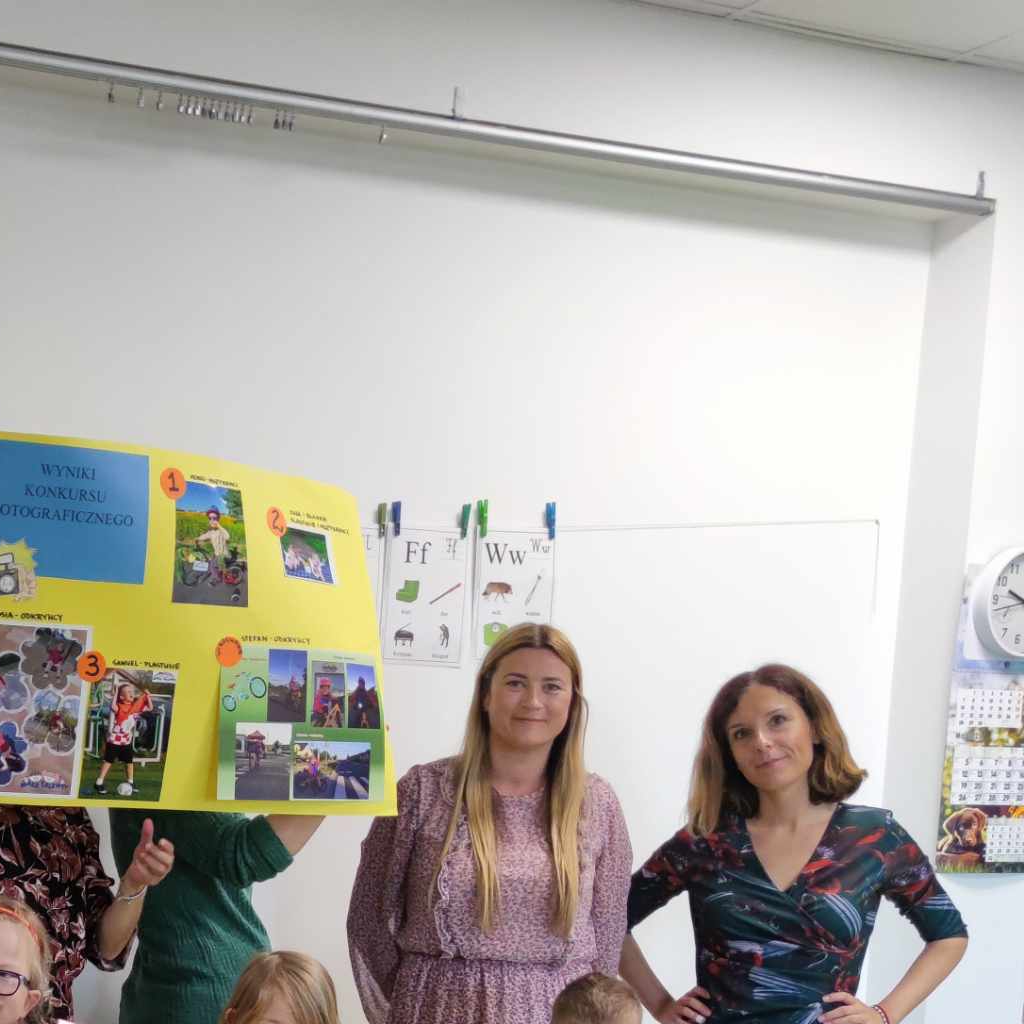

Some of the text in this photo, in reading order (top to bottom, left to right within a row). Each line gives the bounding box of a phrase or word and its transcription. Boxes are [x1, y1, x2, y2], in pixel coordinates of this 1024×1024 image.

[40, 463, 96, 480] WYNIKI
[168, 472, 180, 492] 1
[24, 484, 106, 503] KONKURSU
[271, 509, 284, 533] 2
[405, 541, 432, 564] Ff
[485, 542, 526, 566] Ww
[1009, 560, 1020, 574] 11
[997, 576, 1008, 587] 10
[992, 594, 999, 605] 9
[1001, 627, 1008, 639] 7
[1014, 634, 1021, 645] 6
[85, 654, 100, 676] 3
